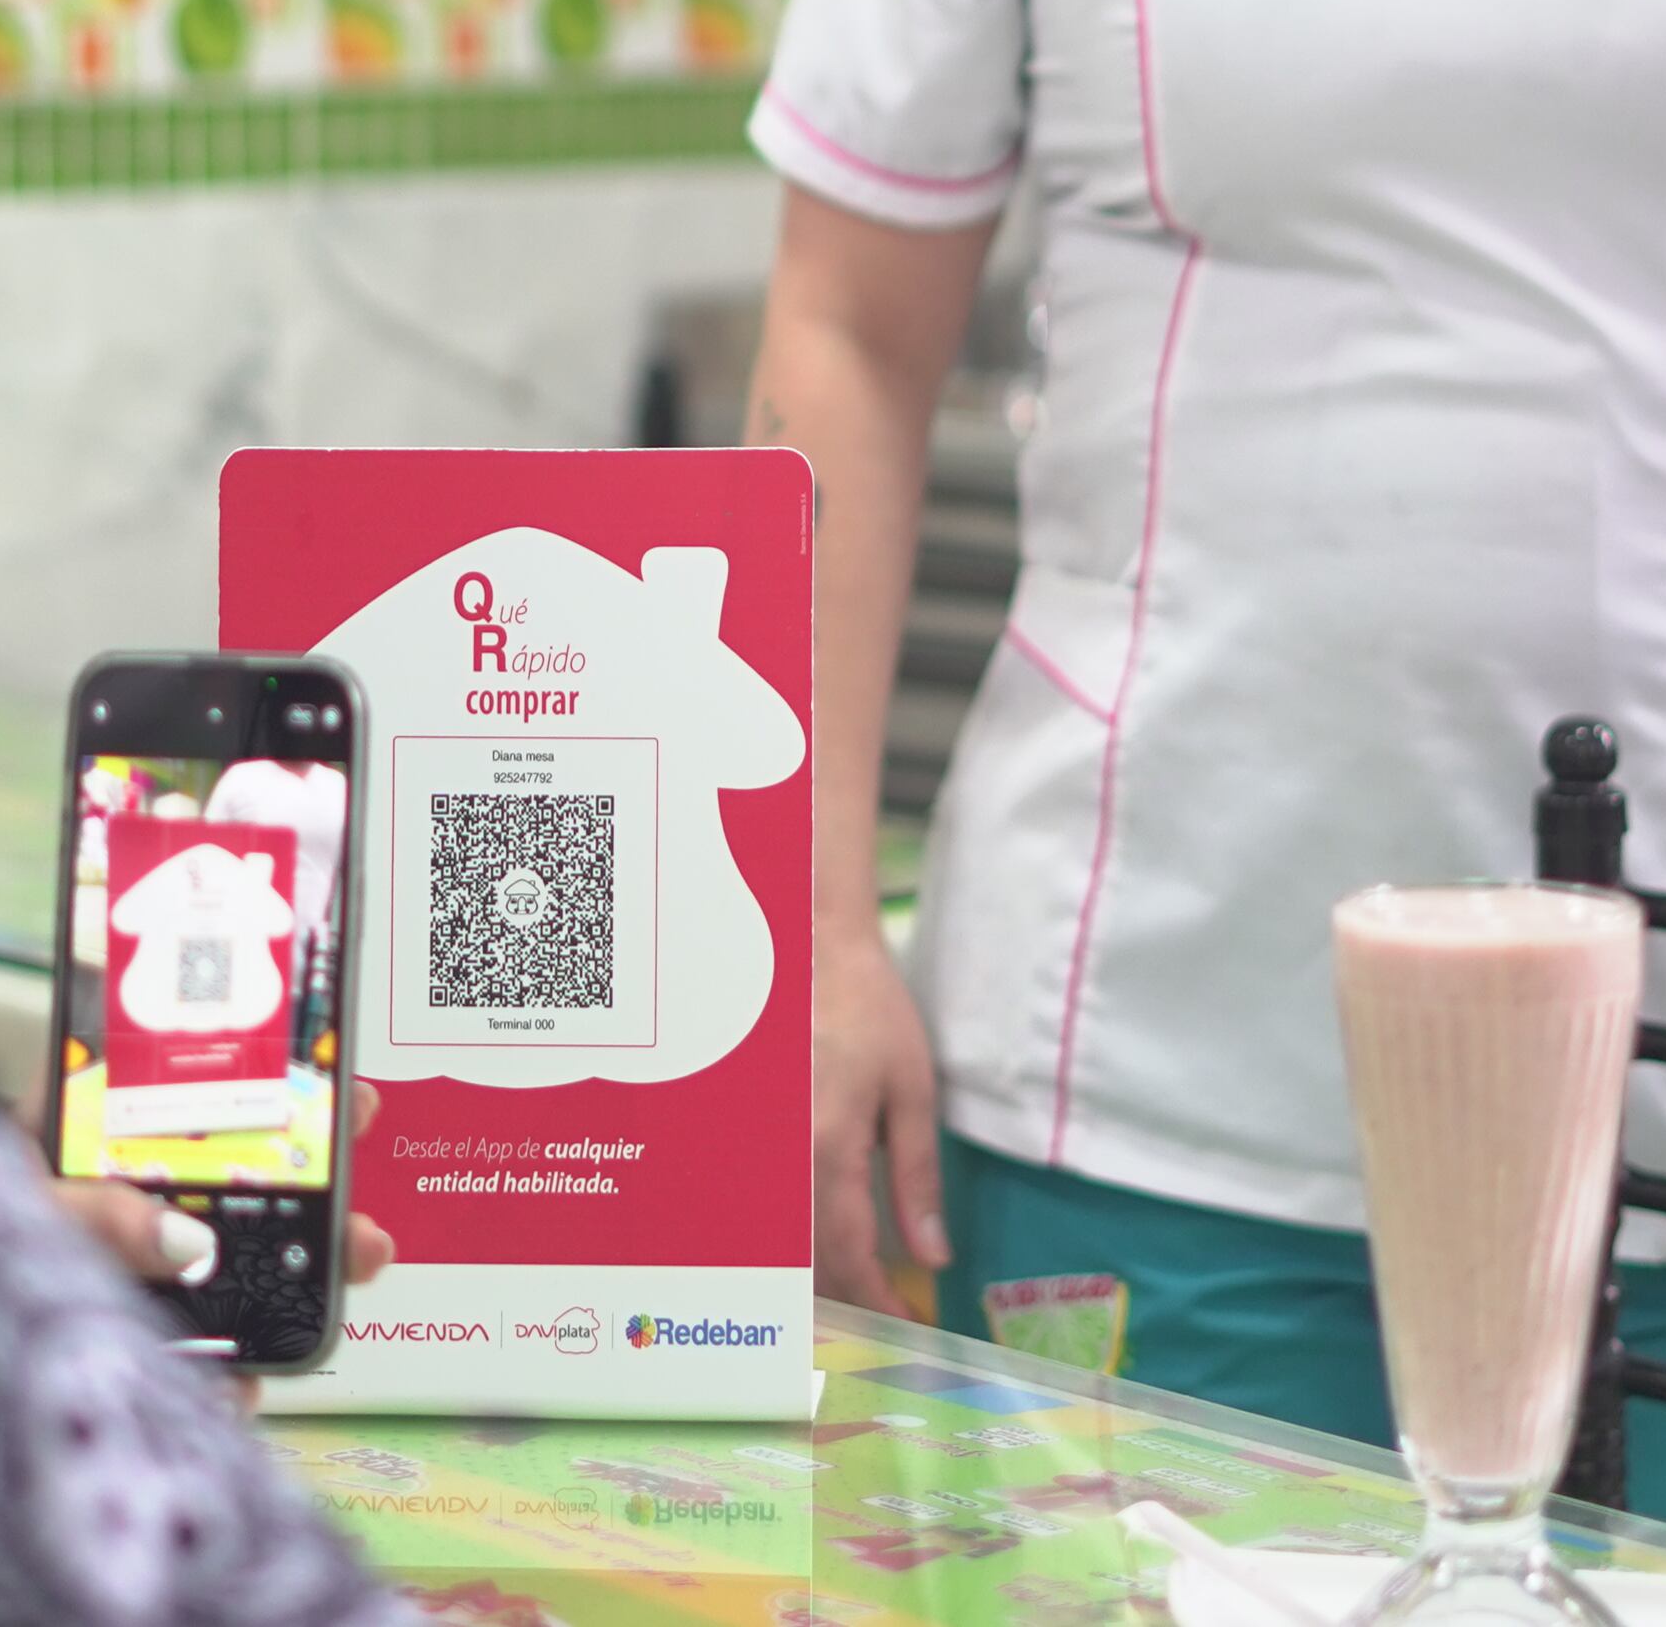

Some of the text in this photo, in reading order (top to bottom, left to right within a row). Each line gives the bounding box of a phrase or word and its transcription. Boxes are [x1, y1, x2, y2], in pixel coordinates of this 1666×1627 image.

[465, 690, 580, 724] comprar
[492, 749, 555, 763] Diana mesa
[487, 1018, 555, 1031] Terminal 000
[393, 1136, 645, 1165] Desde el App de cualquier
[416, 1171, 620, 1195] entidad habilitada.
[339, 1322, 490, 1343] VIVIENDA
